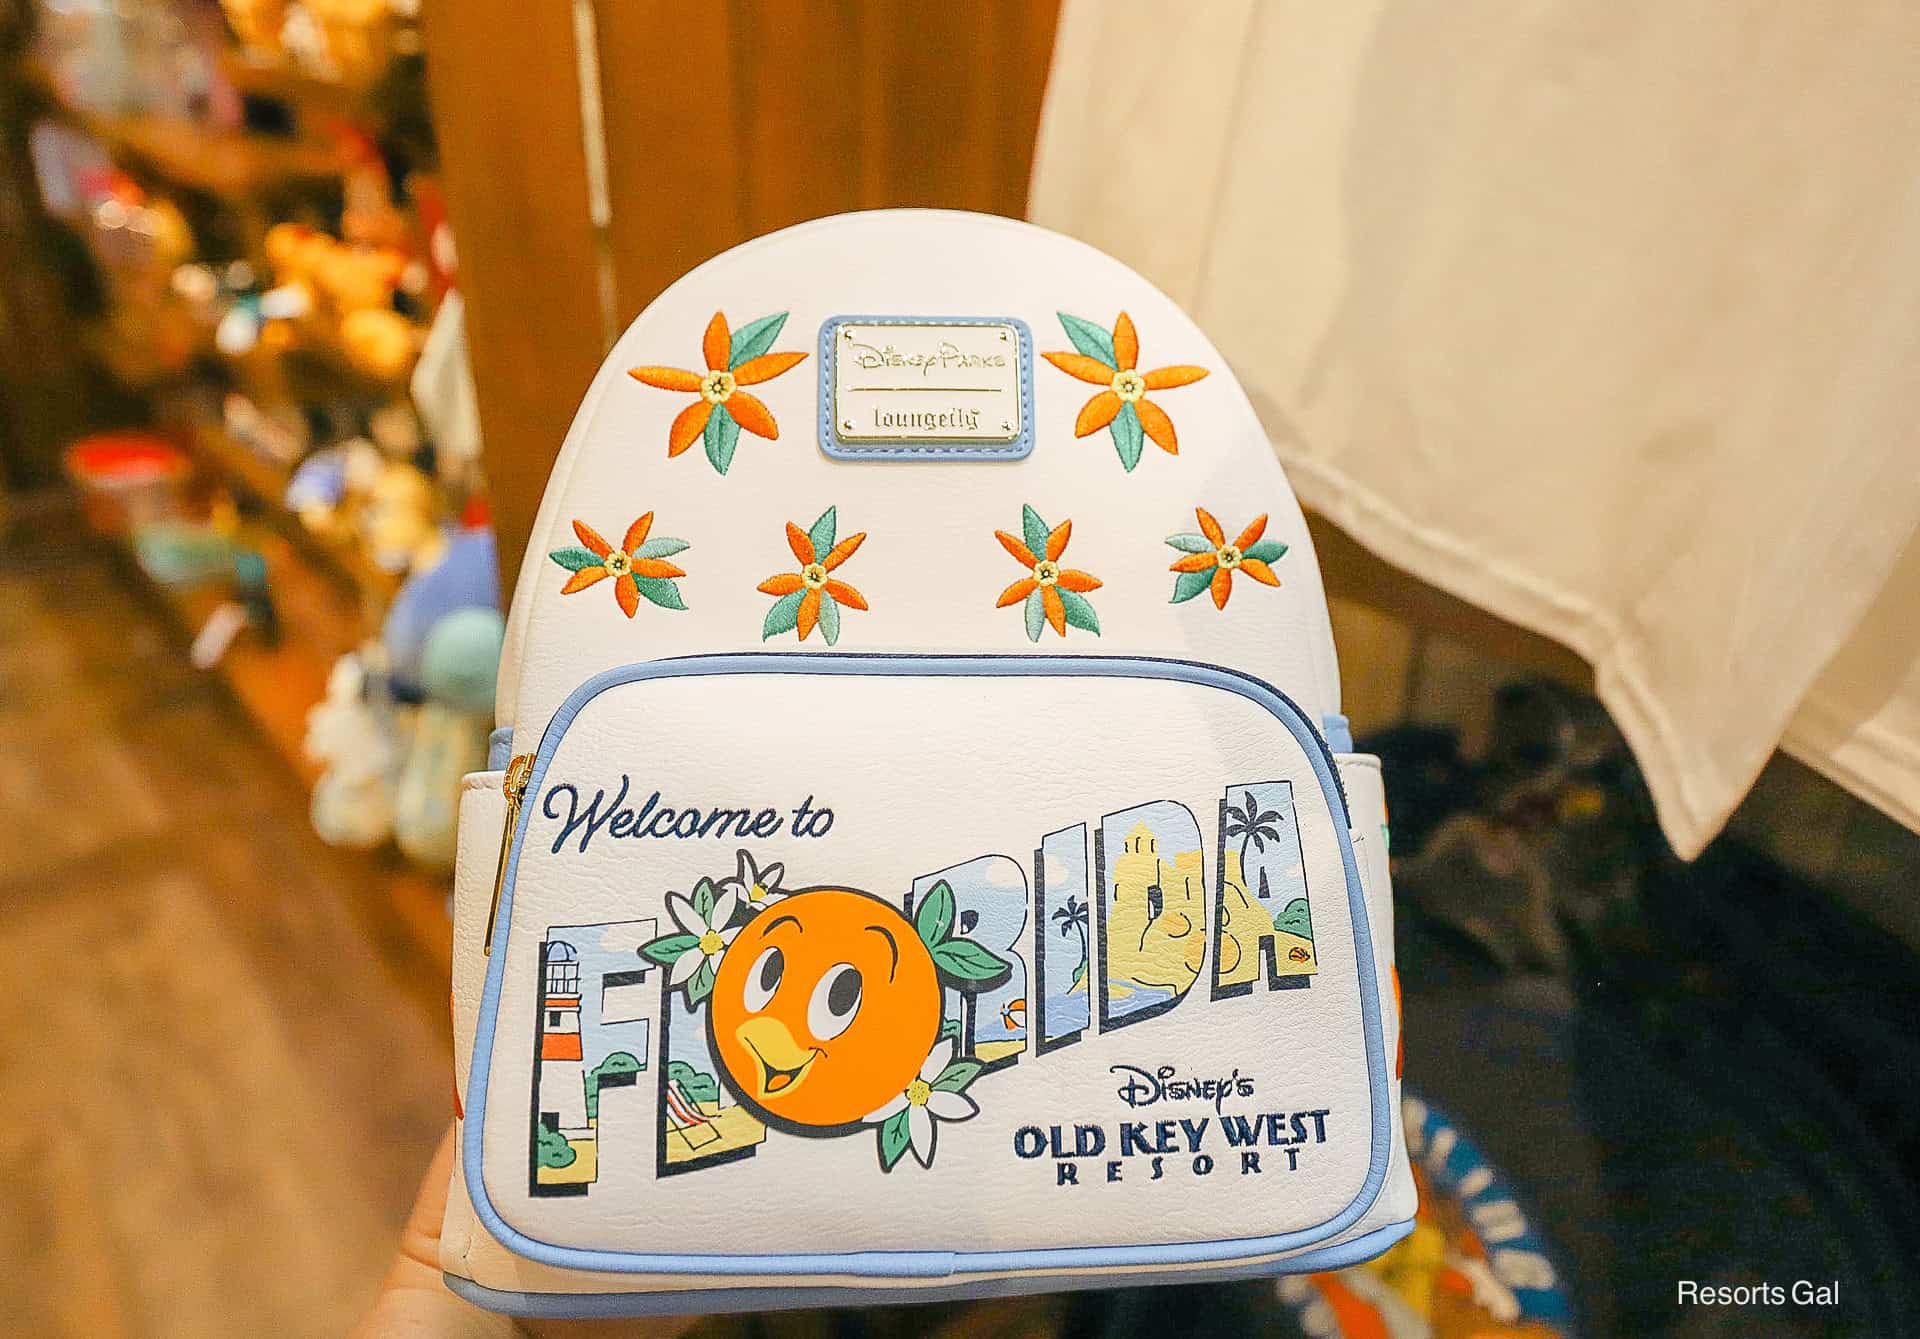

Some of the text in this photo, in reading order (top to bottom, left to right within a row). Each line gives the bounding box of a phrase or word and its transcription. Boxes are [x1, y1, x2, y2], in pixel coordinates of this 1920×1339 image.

[543, 774, 835, 854] Welcome to
[1014, 1109, 1330, 1159] OLD KEY WEST
[1056, 1148, 1301, 1187] RESORT
